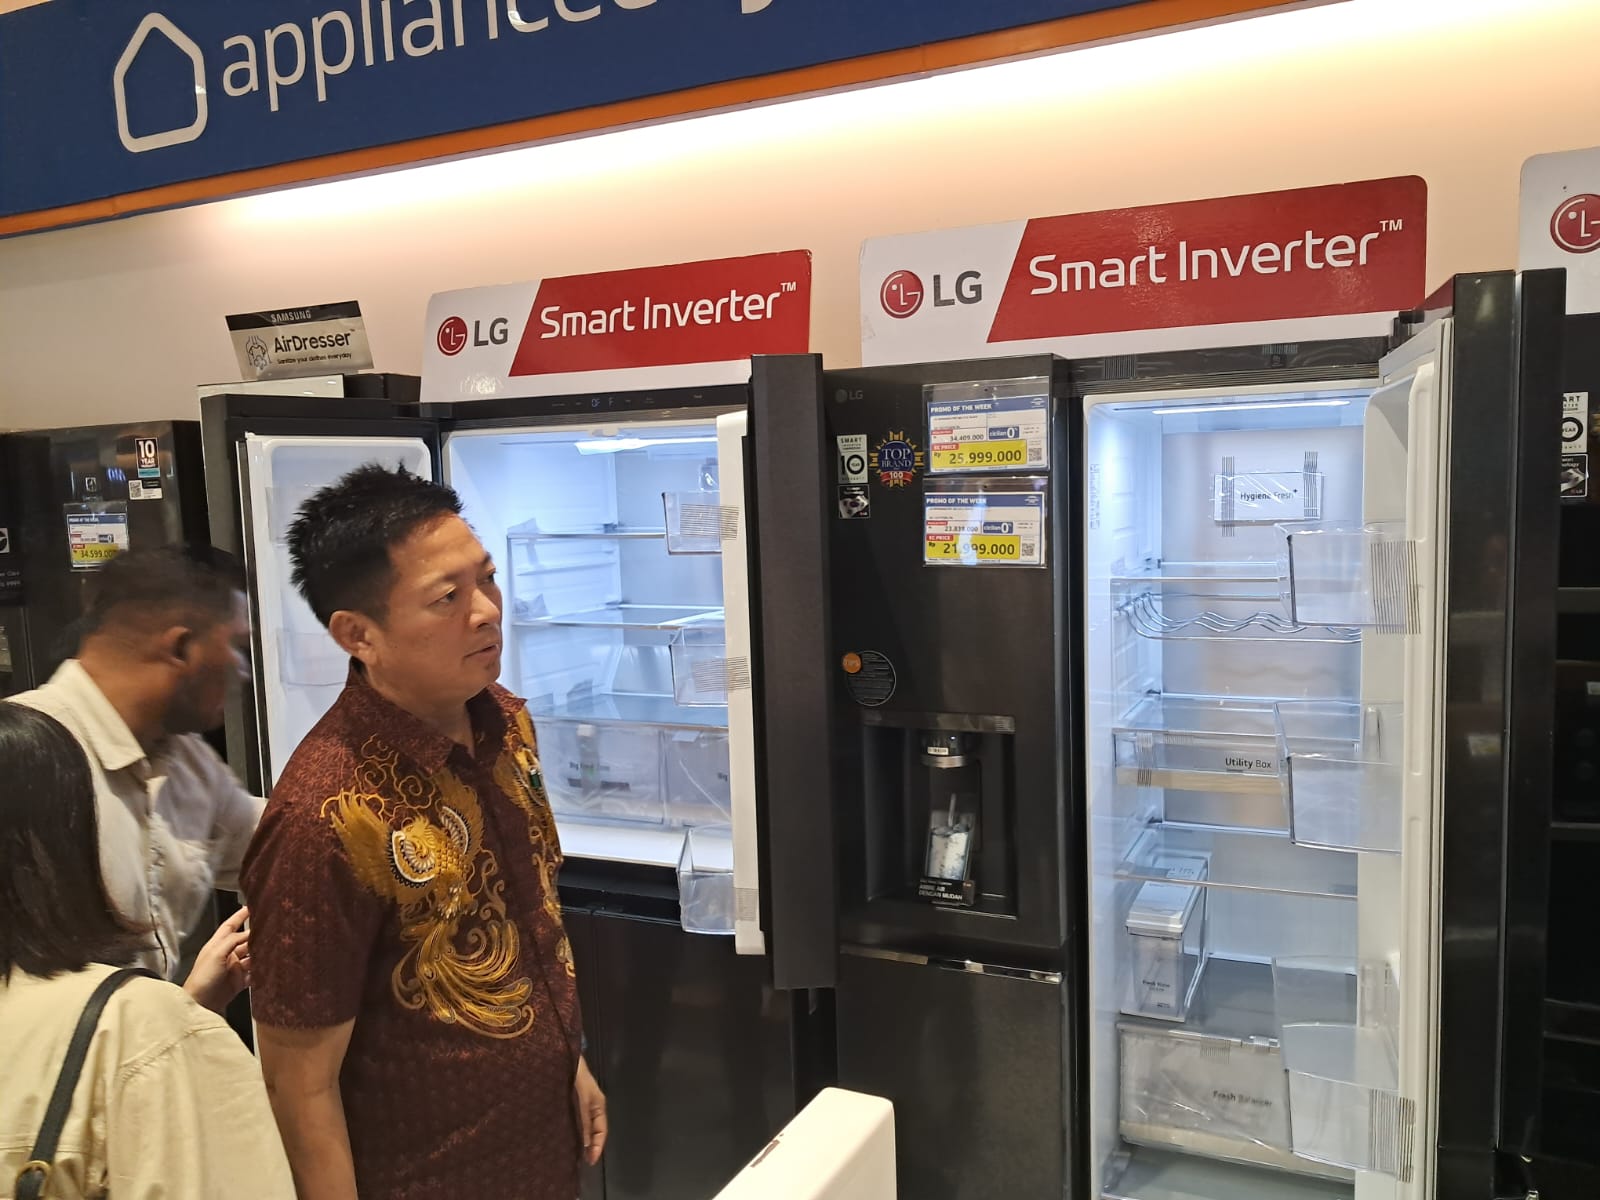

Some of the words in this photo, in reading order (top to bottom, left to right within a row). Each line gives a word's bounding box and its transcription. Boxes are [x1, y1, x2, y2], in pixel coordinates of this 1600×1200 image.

[933, 270, 982, 307] LG
[1029, 245, 1167, 296] Smart
[270, 310, 312, 323] SAMSUNG
[473, 317, 509, 347] LG
[540, 300, 636, 339] Smart
[328, 352, 352, 361] everyday
[931, 404, 952, 414] PROMO
[953, 404, 961, 412] OF
[975, 403, 993, 411] WEEK
[139, 440, 155, 459] 10
[881, 448, 912, 460] TOP
[949, 449, 1022, 465] 25.999.000
[881, 460, 912, 468] BRAND
[889, 471, 904, 479] 100
[80, 549, 118, 559] 34.599.00
[1225, 757, 1253, 770] Utility
[1255, 759, 1272, 769] Box
[1213, 1090, 1236, 1101] Fresh
